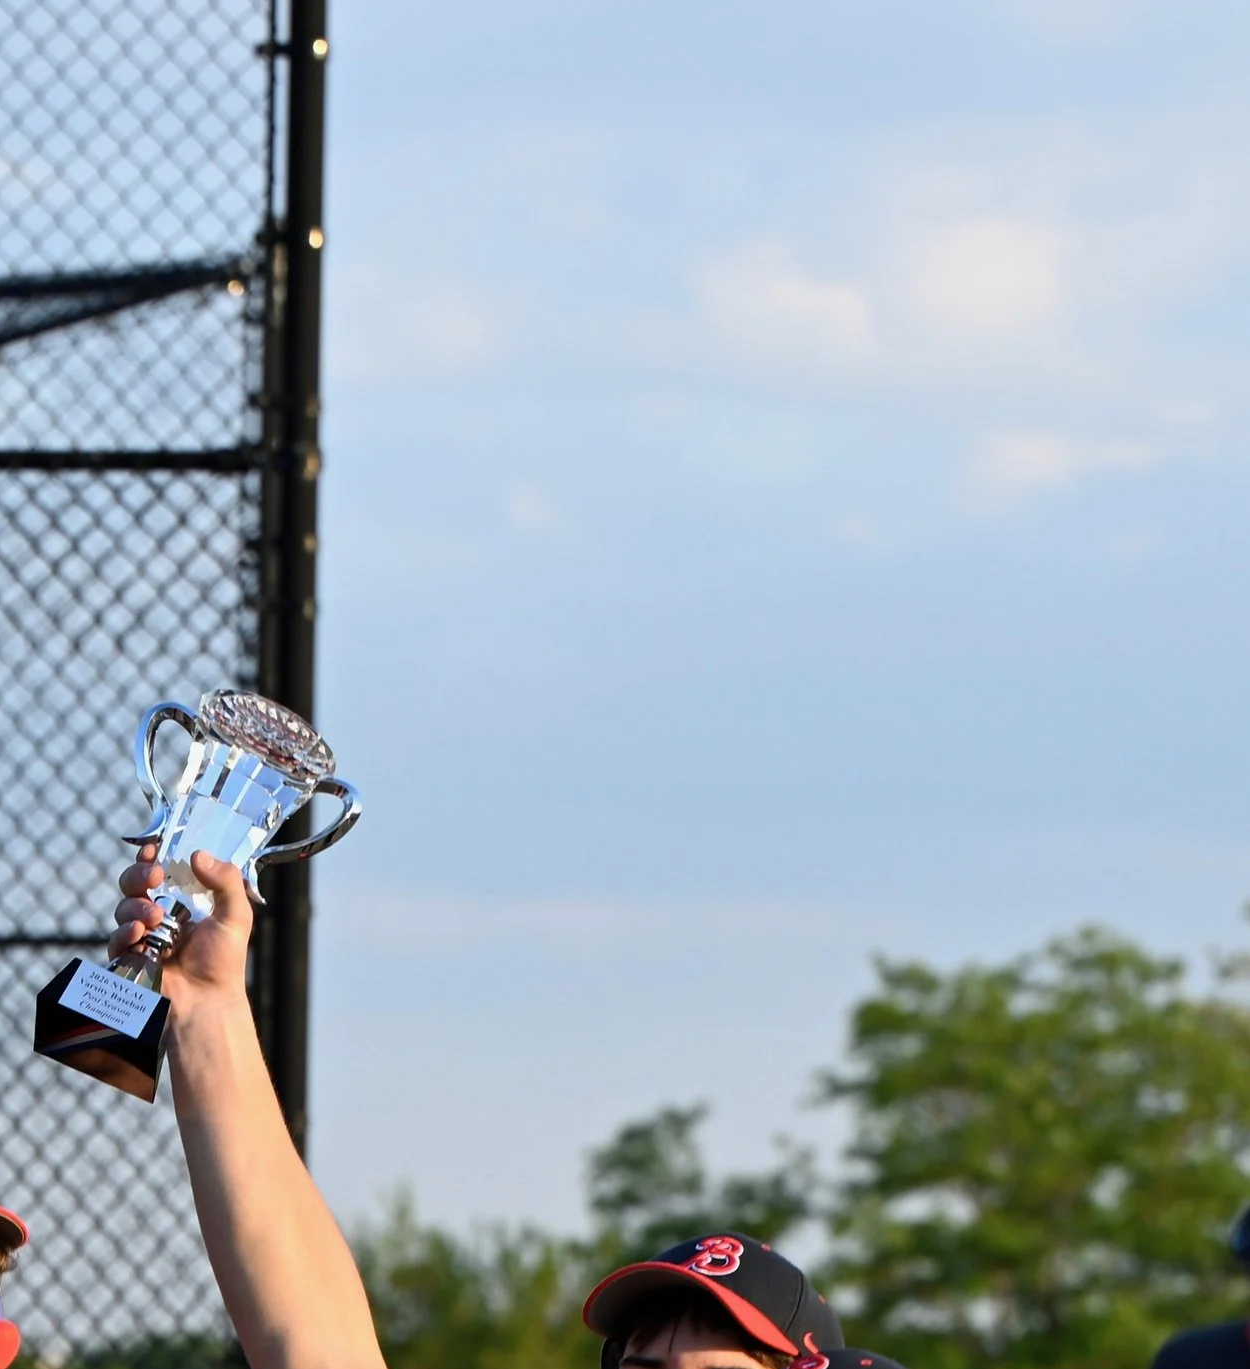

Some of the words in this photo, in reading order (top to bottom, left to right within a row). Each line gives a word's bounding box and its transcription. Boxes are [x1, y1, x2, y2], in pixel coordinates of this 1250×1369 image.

[80, 977, 107, 997] Varsity
[110, 992, 146, 1013] Baseball
[82, 990, 101, 1004] Post
[102, 1000, 131, 1018] Season
[79, 1001, 124, 1025] Champions
[682, 1235, 745, 1277] B
